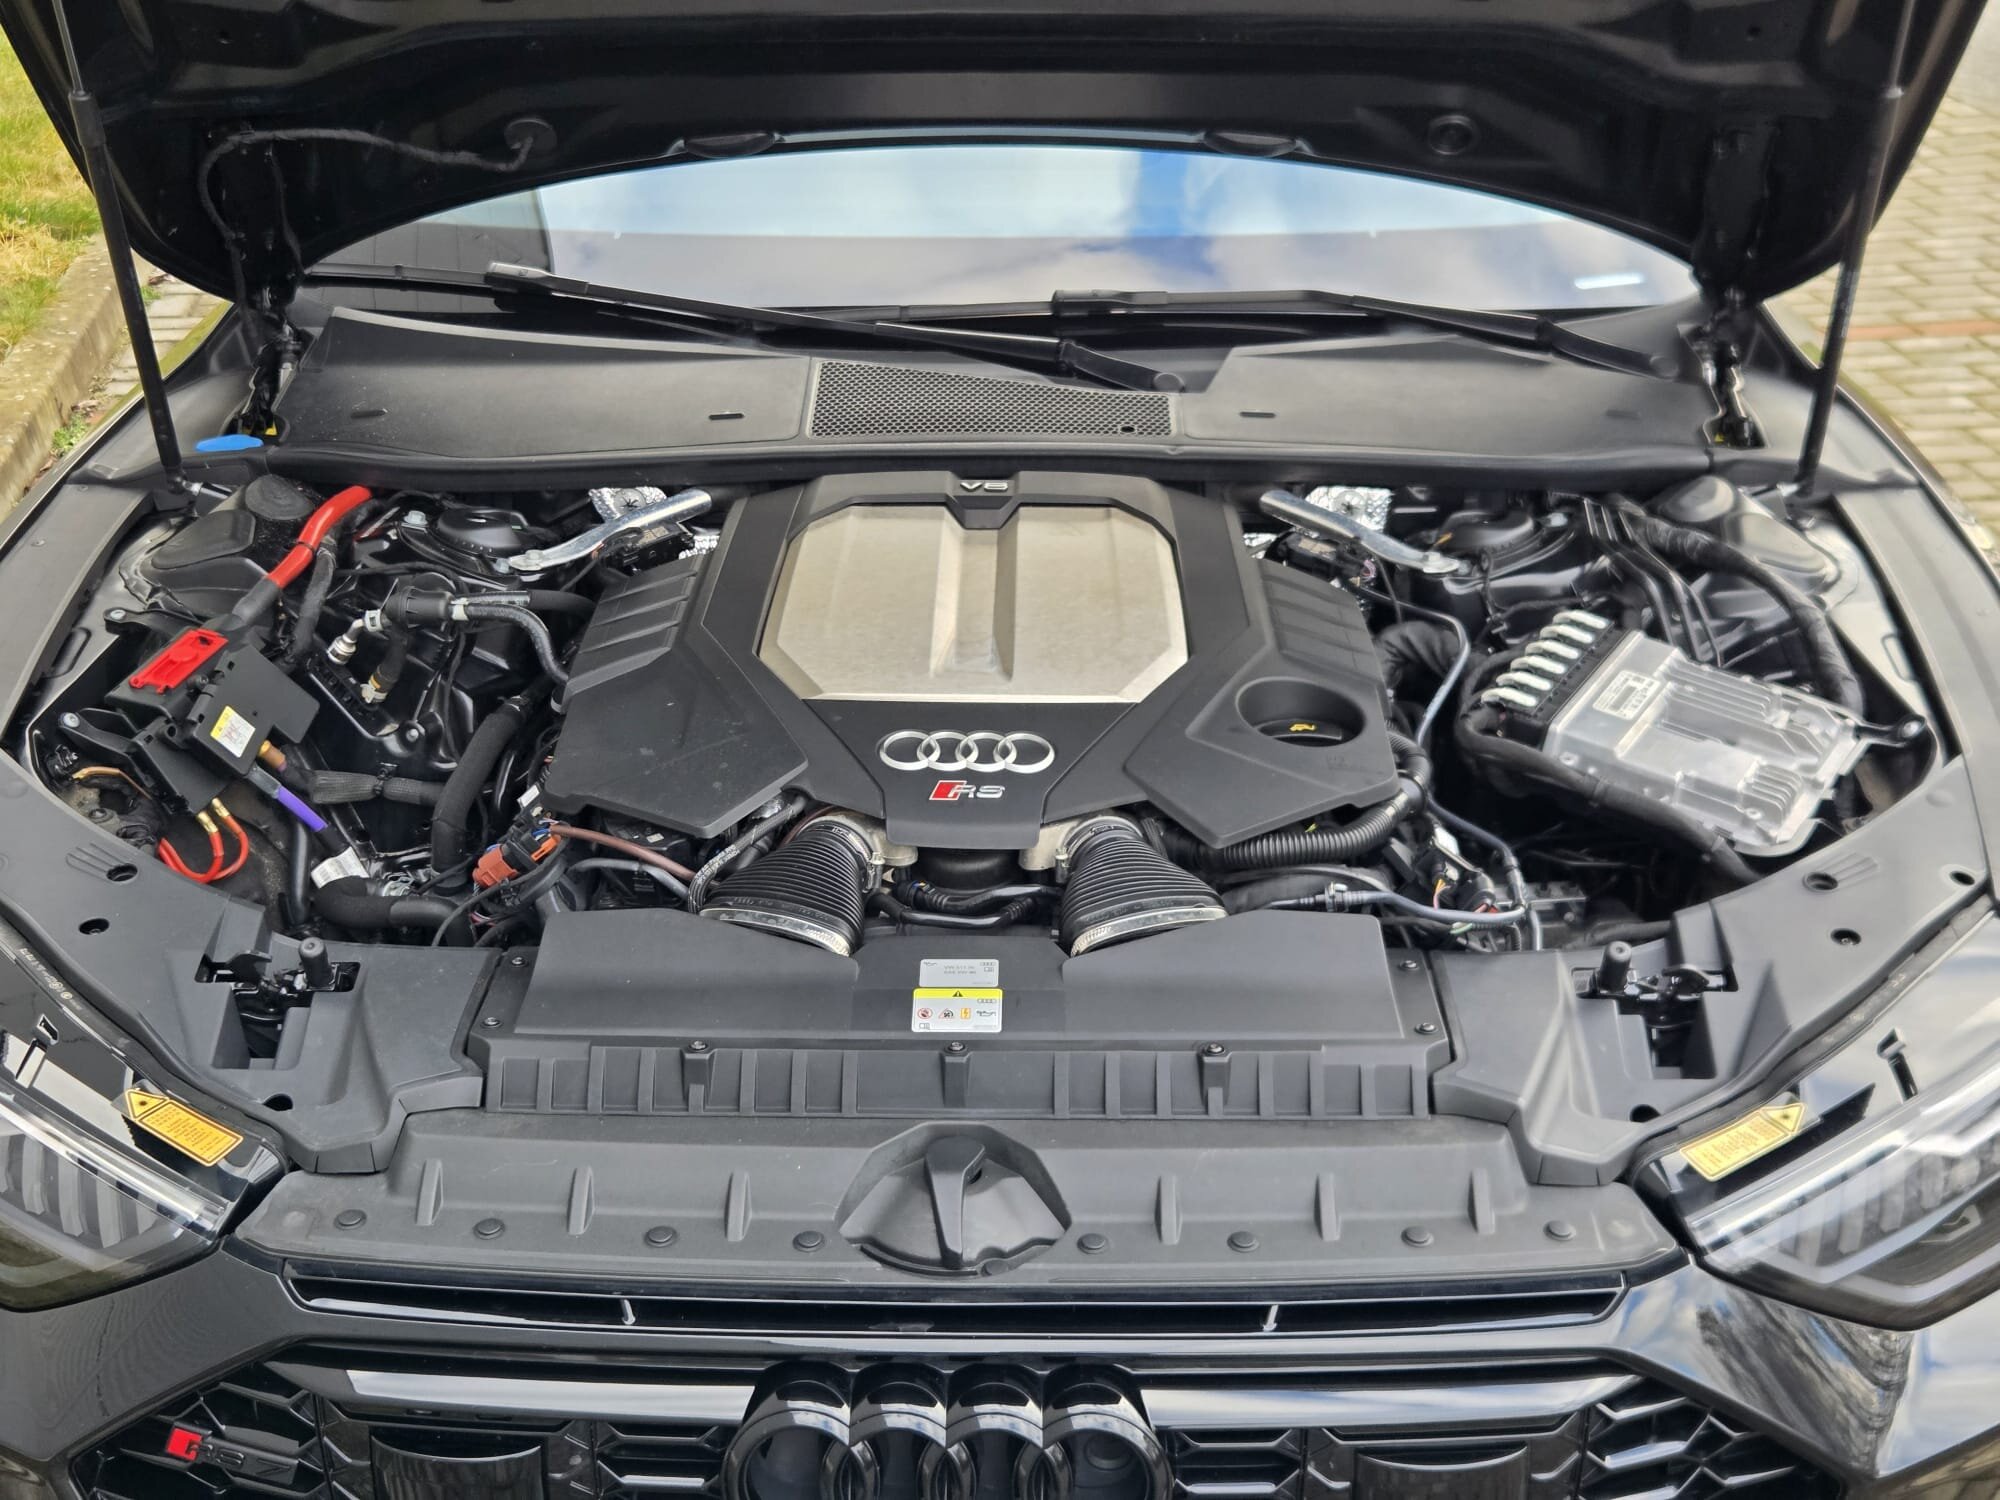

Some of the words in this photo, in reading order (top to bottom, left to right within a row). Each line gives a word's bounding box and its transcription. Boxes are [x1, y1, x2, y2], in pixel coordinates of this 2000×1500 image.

[960, 482, 1008, 492] V8
[947, 784, 1005, 798] RS
[185, 1441, 245, 1467] RS
[255, 1457, 291, 1475] 7
